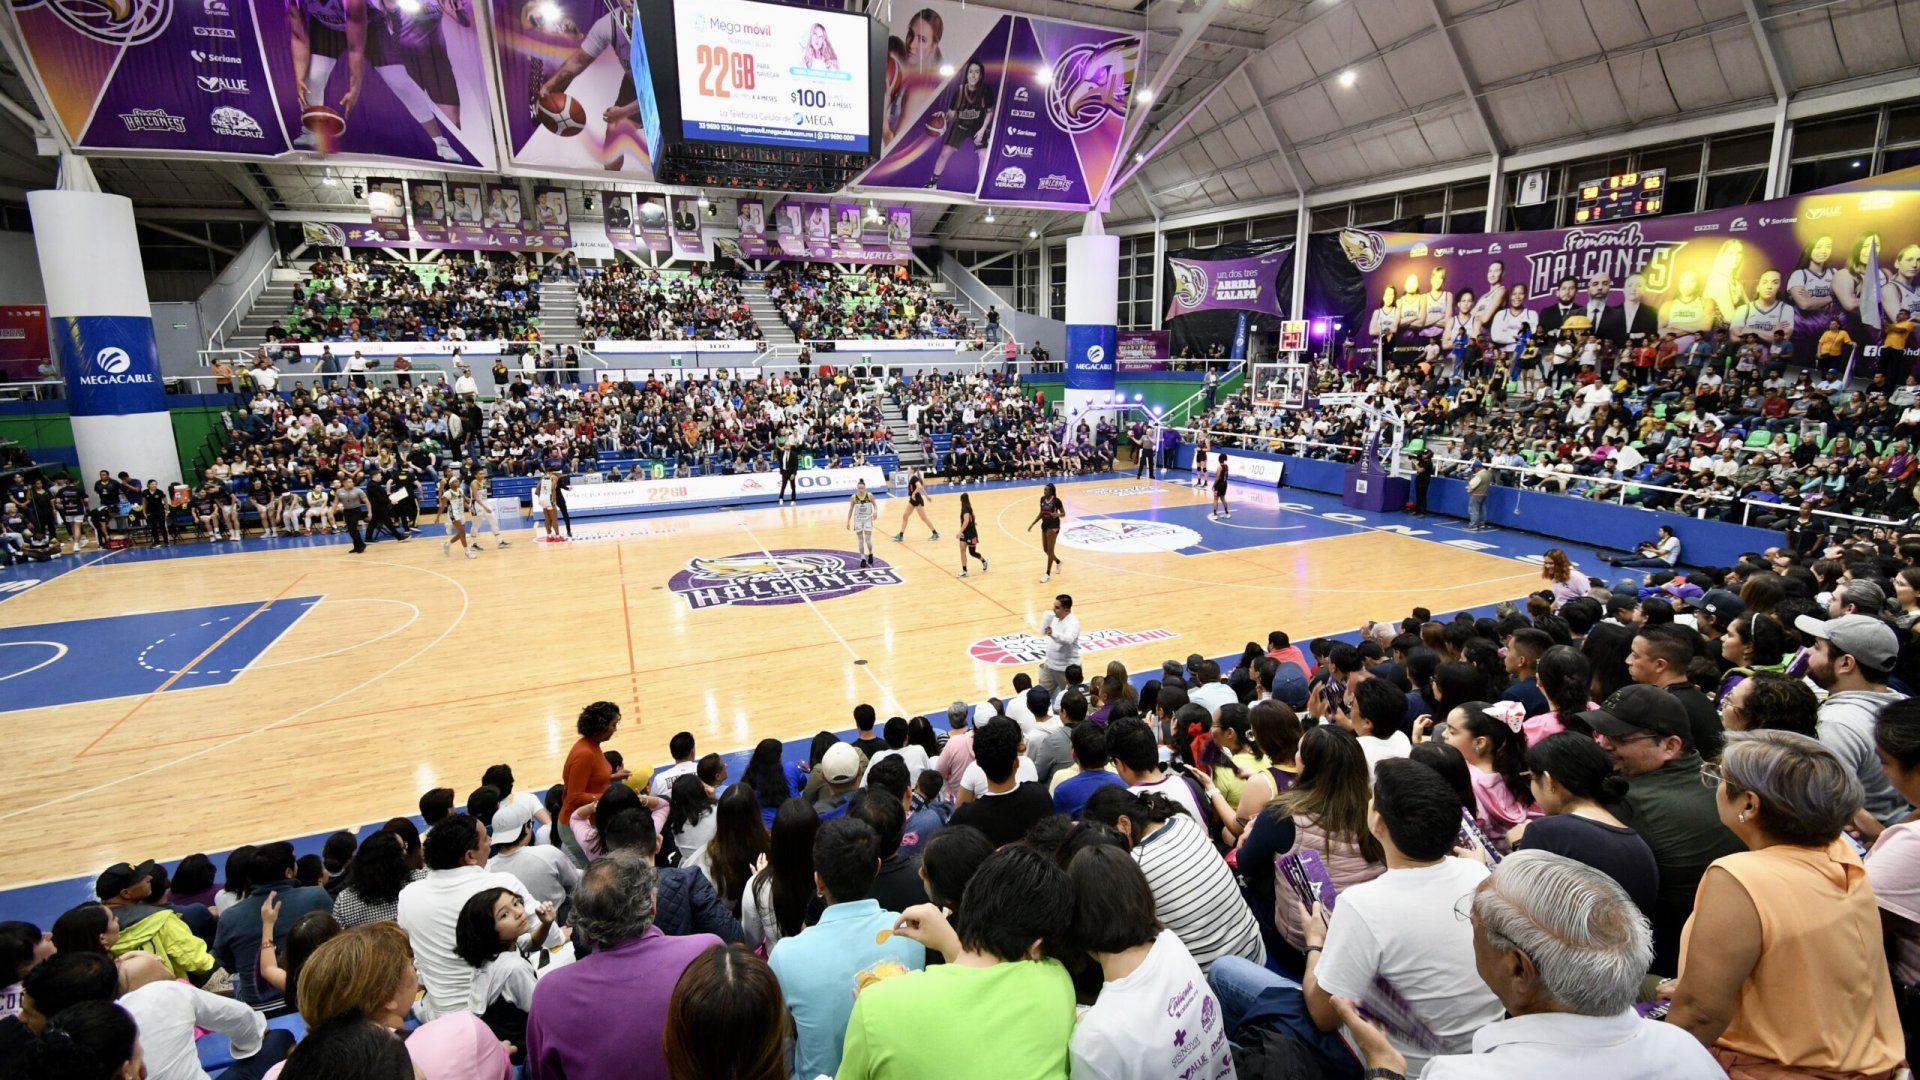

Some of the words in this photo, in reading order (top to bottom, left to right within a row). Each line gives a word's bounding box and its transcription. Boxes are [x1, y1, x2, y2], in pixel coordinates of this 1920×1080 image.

[710, 17, 741, 34] Mega
[743, 24, 771, 36] móvil
[697, 44, 756, 98] 22GB
[197, 75, 250, 93] VALUE
[790, 88, 826, 109] $100
[122, 115, 185, 131] HALCONES
[805, 113, 834, 127] MEGA
[212, 127, 265, 139] VERACRUZ
[995, 181, 1025, 189] VERACRUZ
[1593, 206, 1601, 217] 2
[1634, 201, 1643, 212] 2
[1567, 227, 1641, 250] Femenil
[1243, 268, 1258, 277] tres
[1534, 246, 1671, 294] HALCONES
[1283, 333, 1300, 349] 24
[80, 374, 155, 385] MEGACABLE
[1250, 464, 1266, 476] 100
[646, 486, 688, 501] 22GB
[777, 475, 832, 488] $00
[1075, 527, 1183, 544] VERACRUZ
[683, 569, 903, 609] HALCONES
[992, 632, 1033, 643] LIGA
[1081, 629, 1178, 651] FEMENIL
